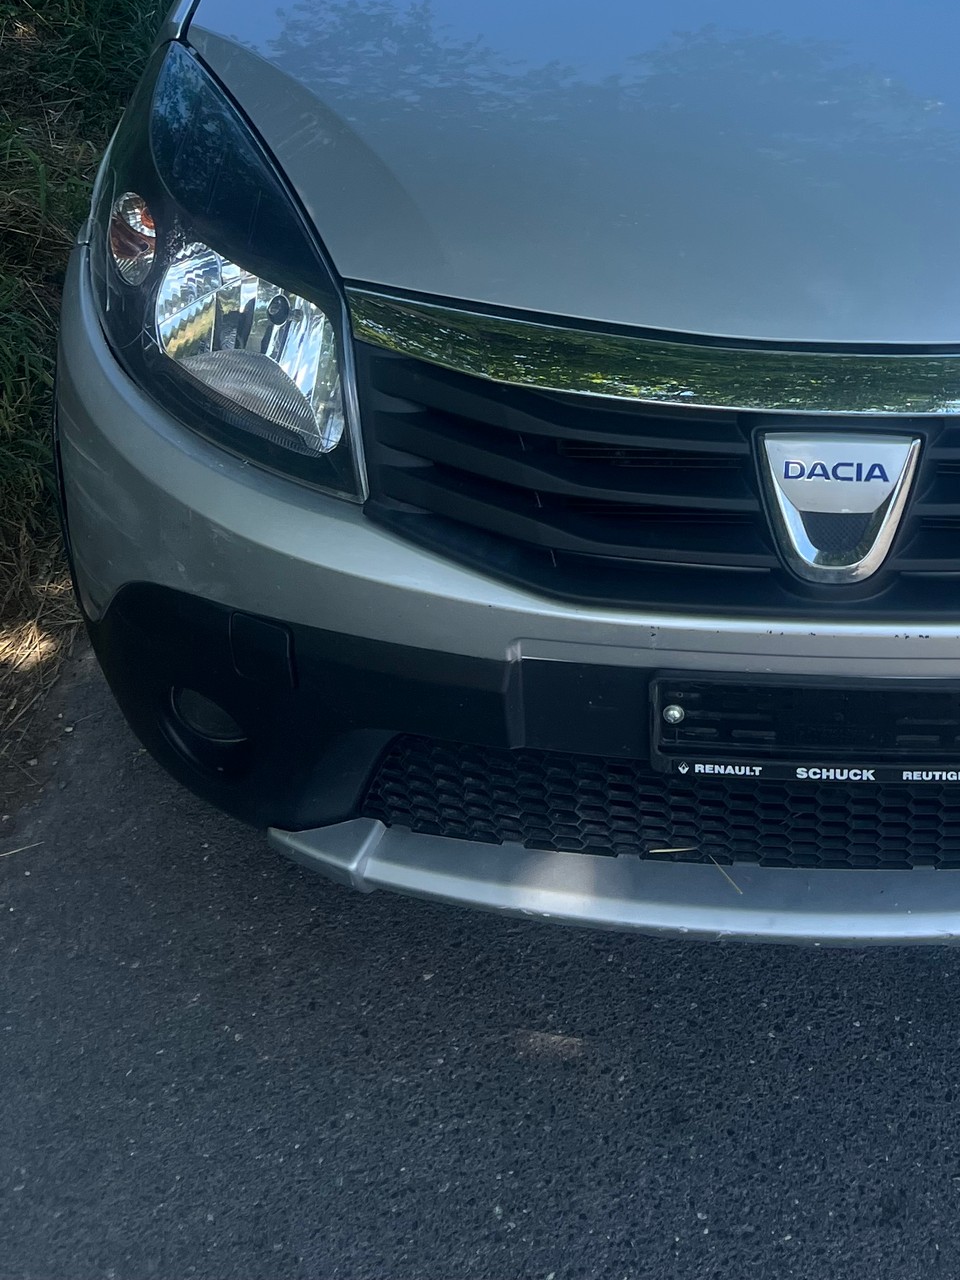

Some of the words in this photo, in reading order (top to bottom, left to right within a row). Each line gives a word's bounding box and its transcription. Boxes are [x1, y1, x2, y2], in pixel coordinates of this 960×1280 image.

[784, 460, 890, 482] DACIA
[694, 763, 763, 776] RENAULT
[796, 767, 876, 781] SCHUCK
